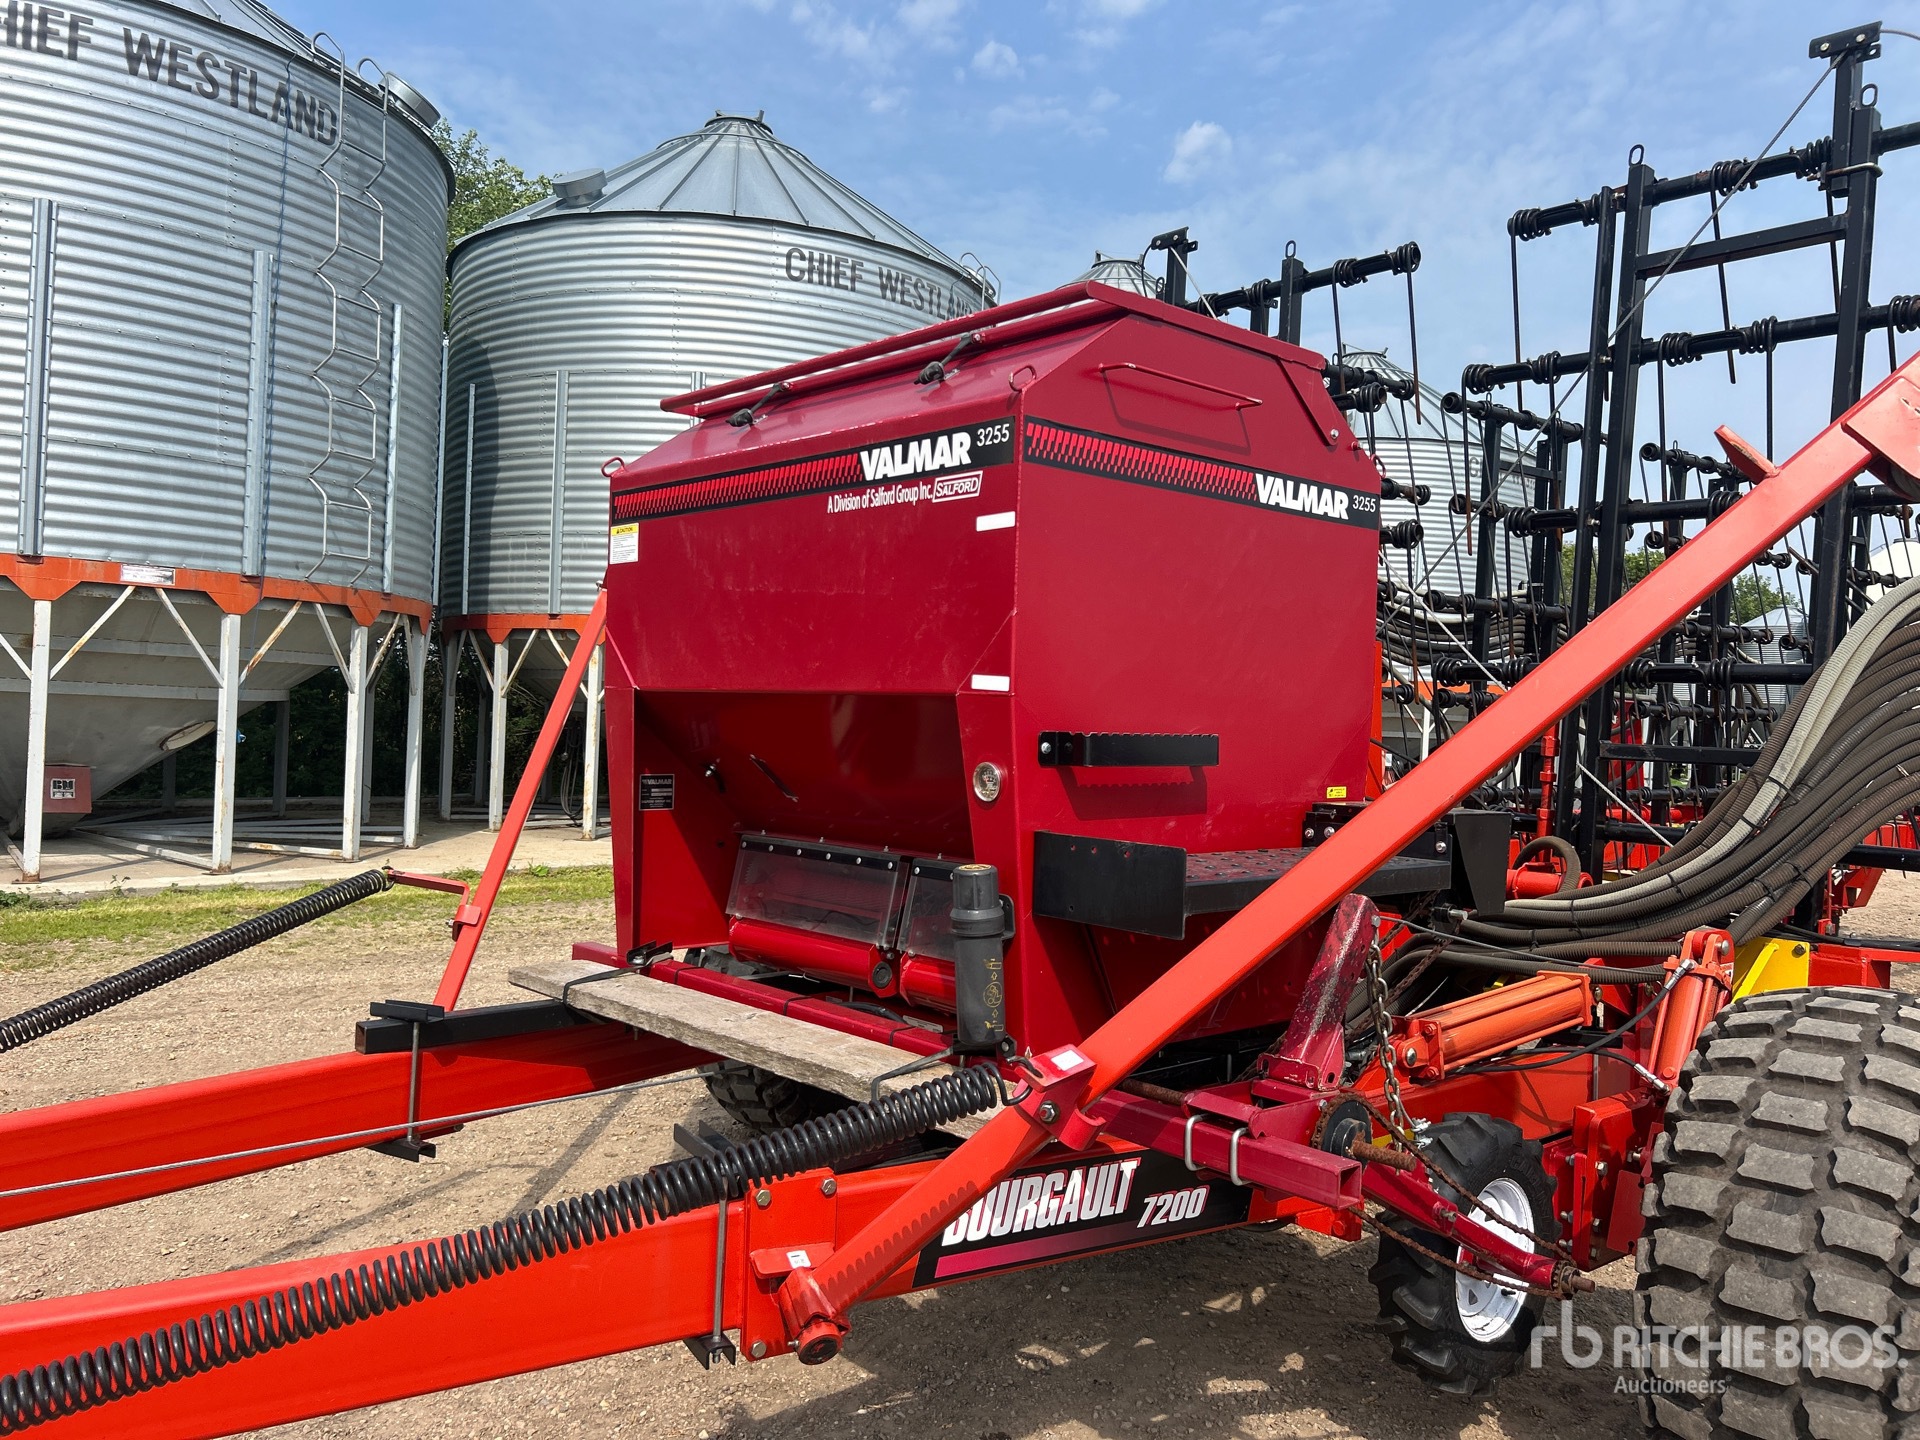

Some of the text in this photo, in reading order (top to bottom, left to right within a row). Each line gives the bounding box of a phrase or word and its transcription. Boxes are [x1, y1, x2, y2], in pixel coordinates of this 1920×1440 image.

[123, 27, 338, 146] WESTLAND
[785, 247, 864, 292] CHIEF
[860, 423, 1010, 481] VALMAR 3255
[827, 480, 933, 514] A Division of Salford Group Inc.
[934, 475, 980, 498] SALFORD
[1255, 472, 1377, 520] VALMAR 3255
[1137, 1185, 1210, 1229] 7200
